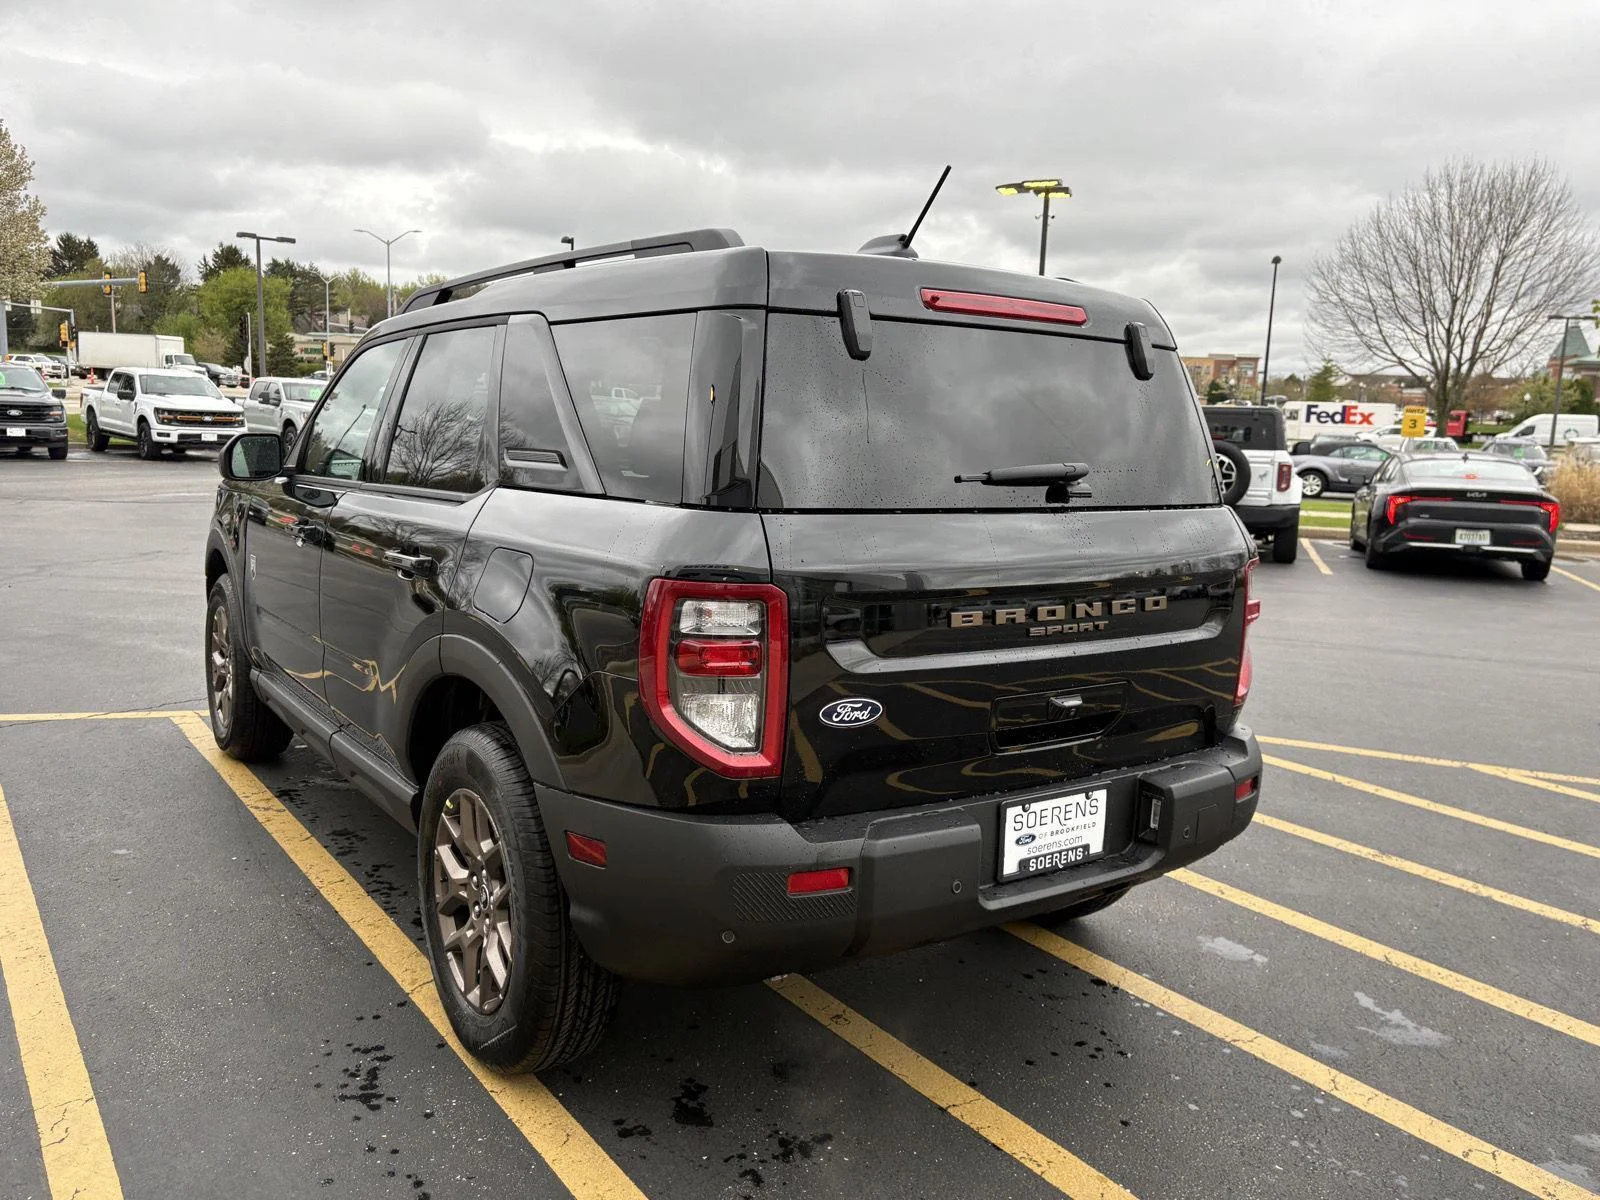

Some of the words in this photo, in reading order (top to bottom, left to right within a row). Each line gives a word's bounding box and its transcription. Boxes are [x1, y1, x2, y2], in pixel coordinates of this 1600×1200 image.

[1305, 404, 1375, 425] FedEx
[1408, 419, 1417, 429] 3
[950, 595, 1168, 628] BRONCO
[1027, 620, 1109, 637] SPORT
[831, 702, 873, 722] Ford
[1013, 798, 1099, 832] SOERENS
[1038, 832, 1049, 840] OF
[1050, 821, 1097, 837] BROOKFIELD
[1026, 835, 1083, 855] soerens.com
[1029, 848, 1084, 872] SOERENS
